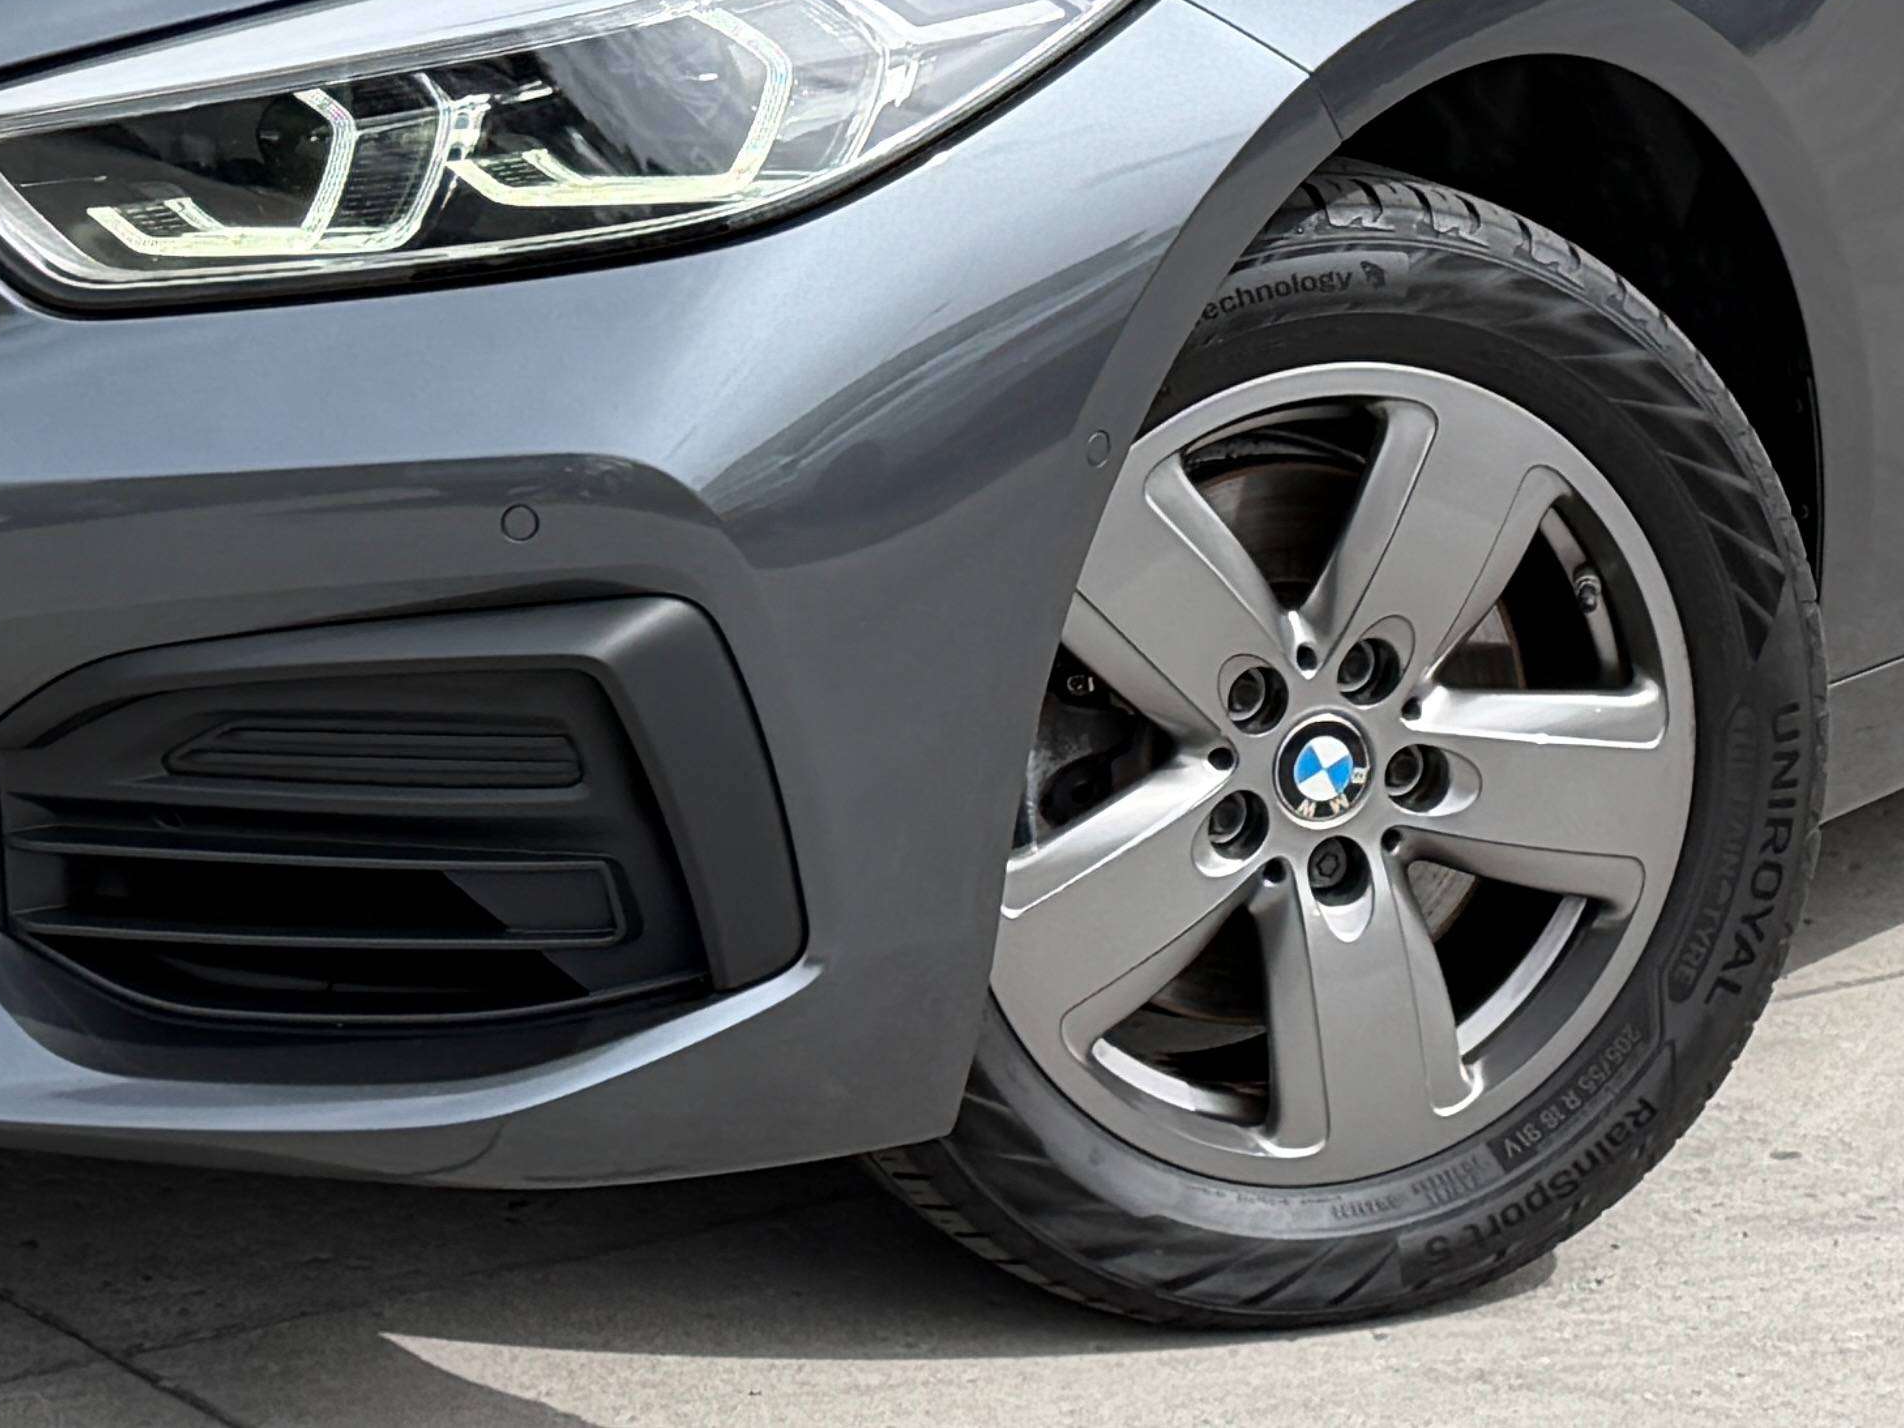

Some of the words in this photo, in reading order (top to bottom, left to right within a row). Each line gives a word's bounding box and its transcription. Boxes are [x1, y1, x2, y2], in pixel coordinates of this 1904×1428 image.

[1202, 271, 1353, 320] echnology
[1704, 702, 1800, 1004] UNIROYAL
[1580, 1023, 1642, 1090] 205/55
[1561, 1089, 1582, 1111] R
[1463, 1095, 1659, 1244] RainSport
[1425, 1235, 1453, 1265] 5
